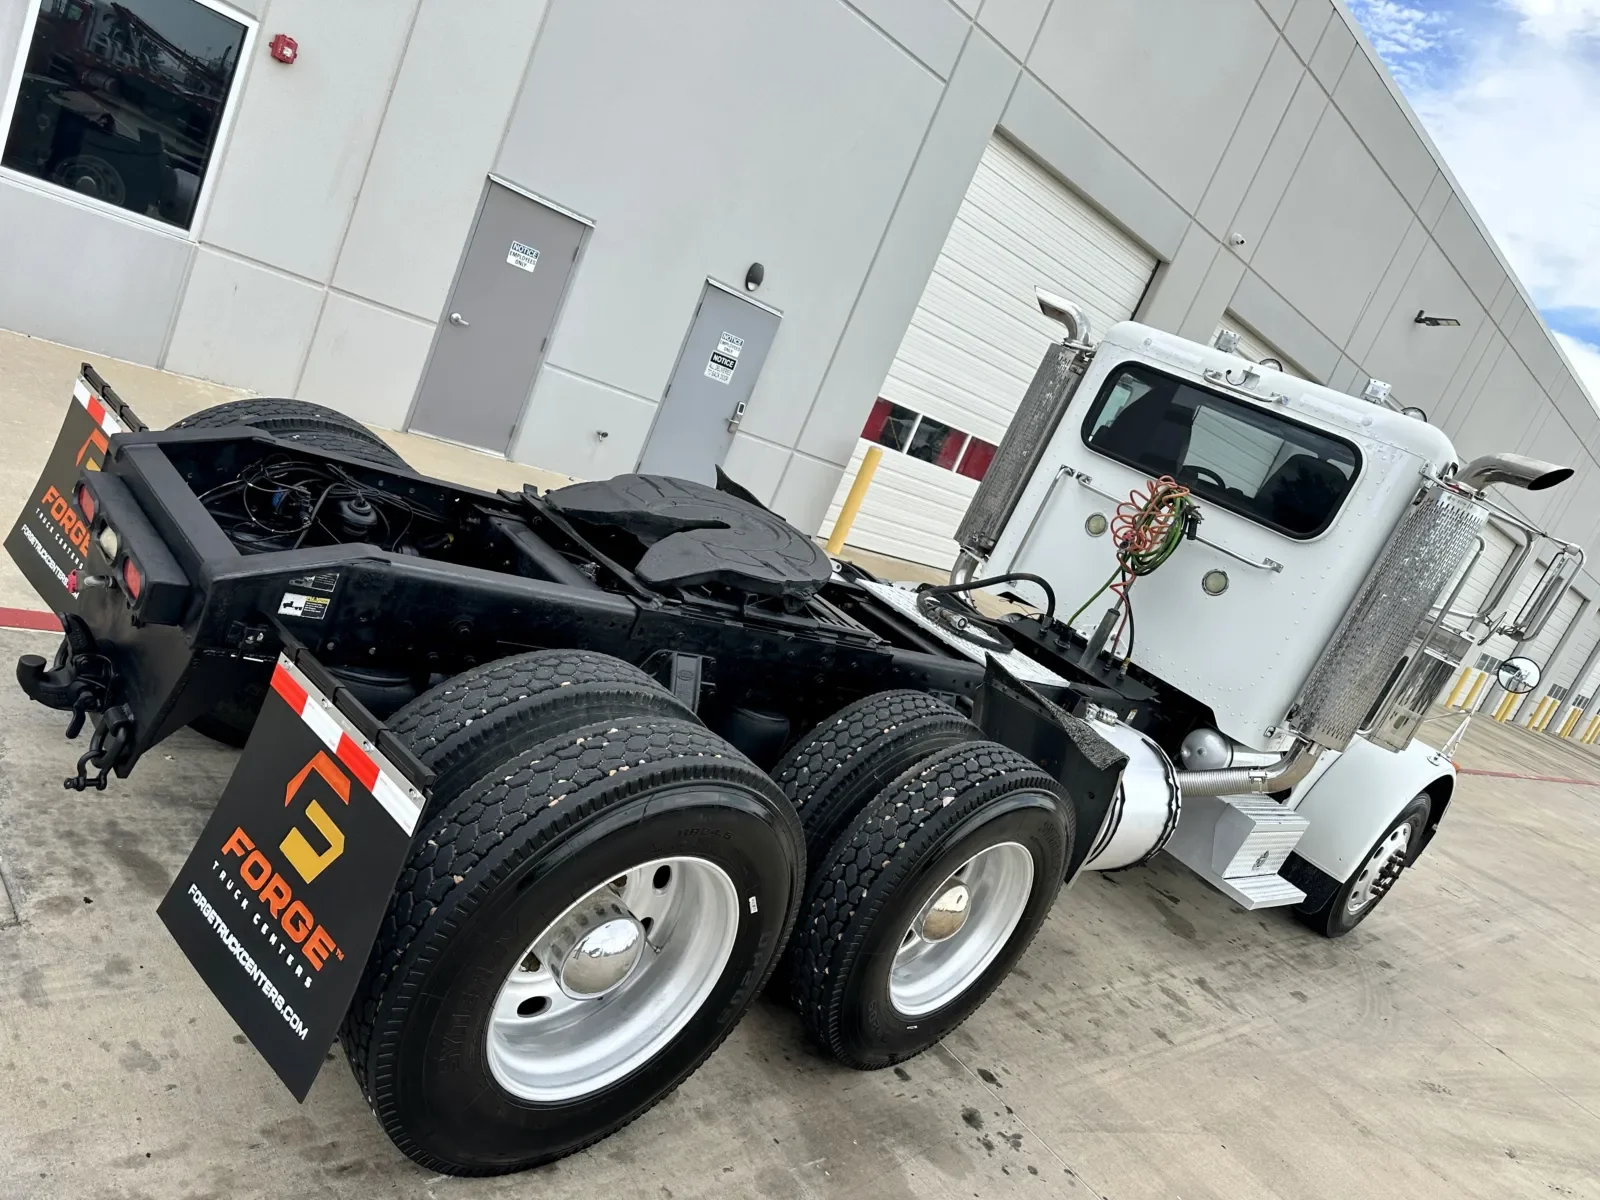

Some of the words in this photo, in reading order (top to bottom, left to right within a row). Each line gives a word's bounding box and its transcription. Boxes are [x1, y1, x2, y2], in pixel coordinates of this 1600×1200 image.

[509, 250, 536, 265] EMPLOYEES
[513, 243, 538, 259] NOTICE
[515, 259, 527, 268] ONLY
[722, 333, 743, 346] NOTICE
[713, 354, 735, 368] NOTICE
[35, 507, 54, 533] TRUCK
[55, 533, 83, 570] CENTERS
[41, 485, 91, 558] FORGE
[221, 826, 336, 971] FORGE
[212, 860, 249, 910] TRUCK
[253, 913, 313, 988] CENTERS
[188, 883, 309, 1040] FORGETRUCKCENTERS.COM
